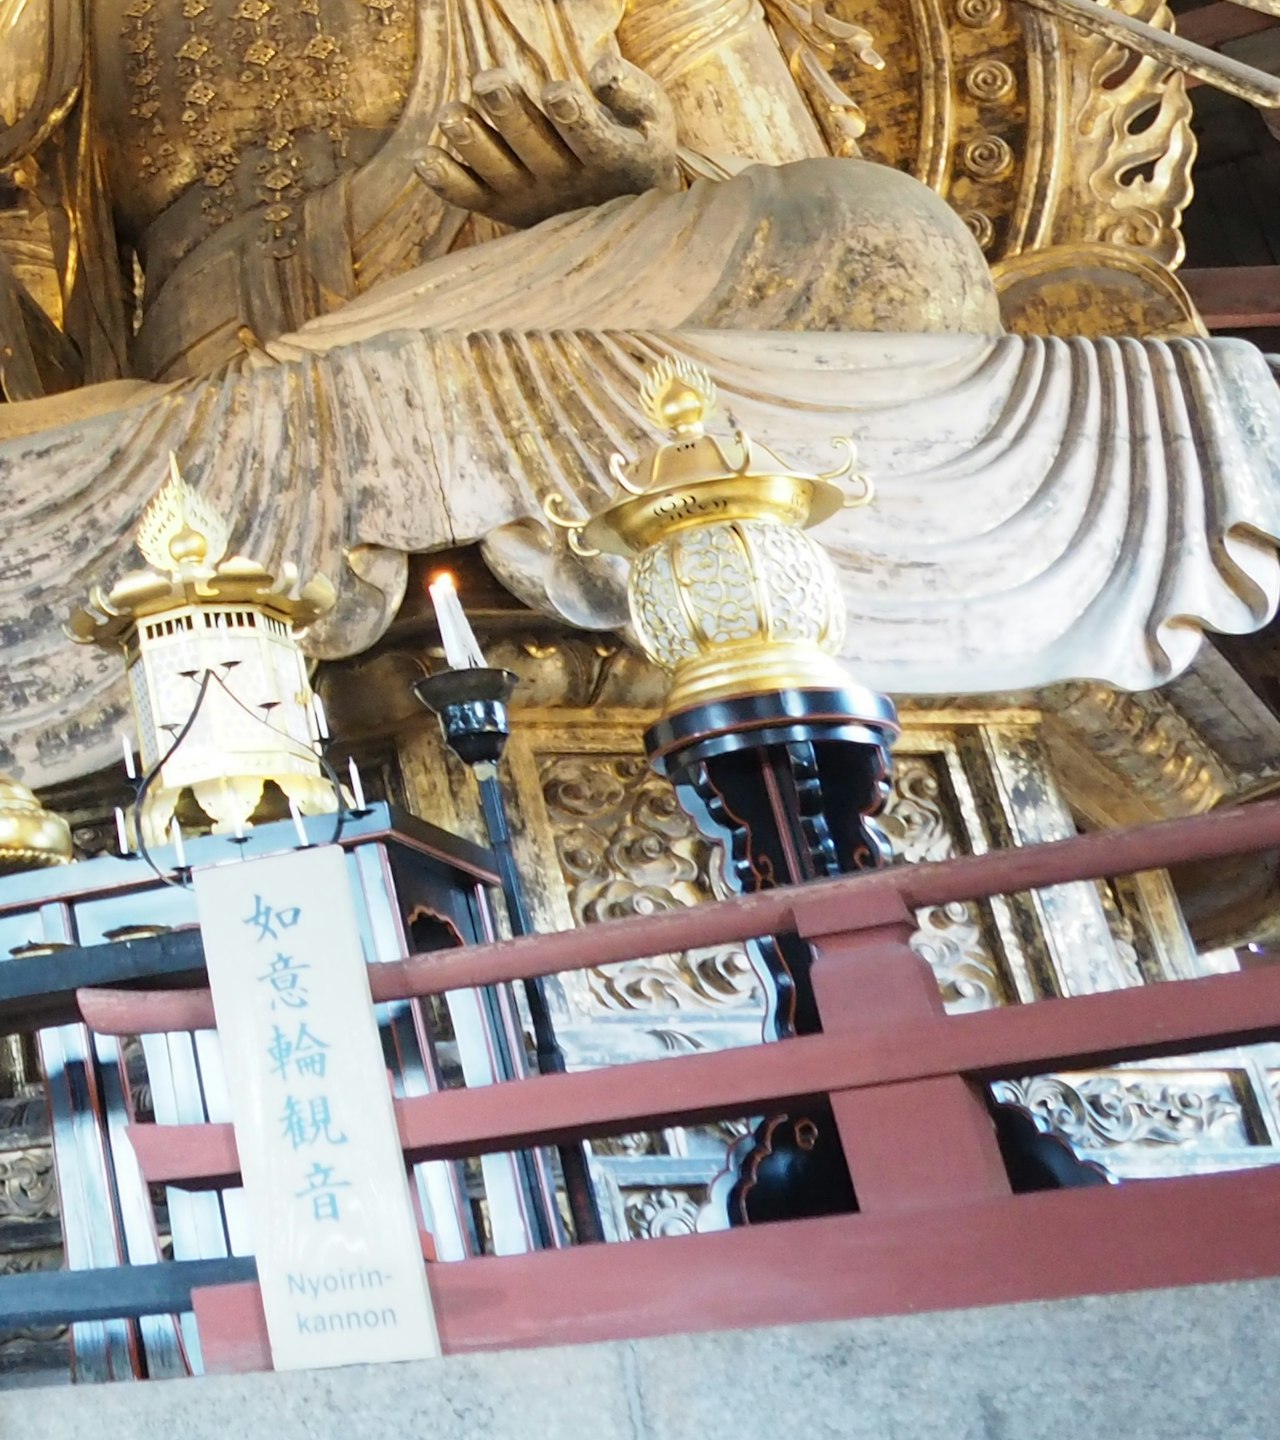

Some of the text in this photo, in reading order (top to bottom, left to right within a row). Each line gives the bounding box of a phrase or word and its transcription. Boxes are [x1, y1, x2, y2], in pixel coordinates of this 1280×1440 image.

[243, 893, 352, 1222] 如意輪観音
[287, 1266, 393, 1300] Nyoirin-
[296, 1307, 397, 1334] kannon
